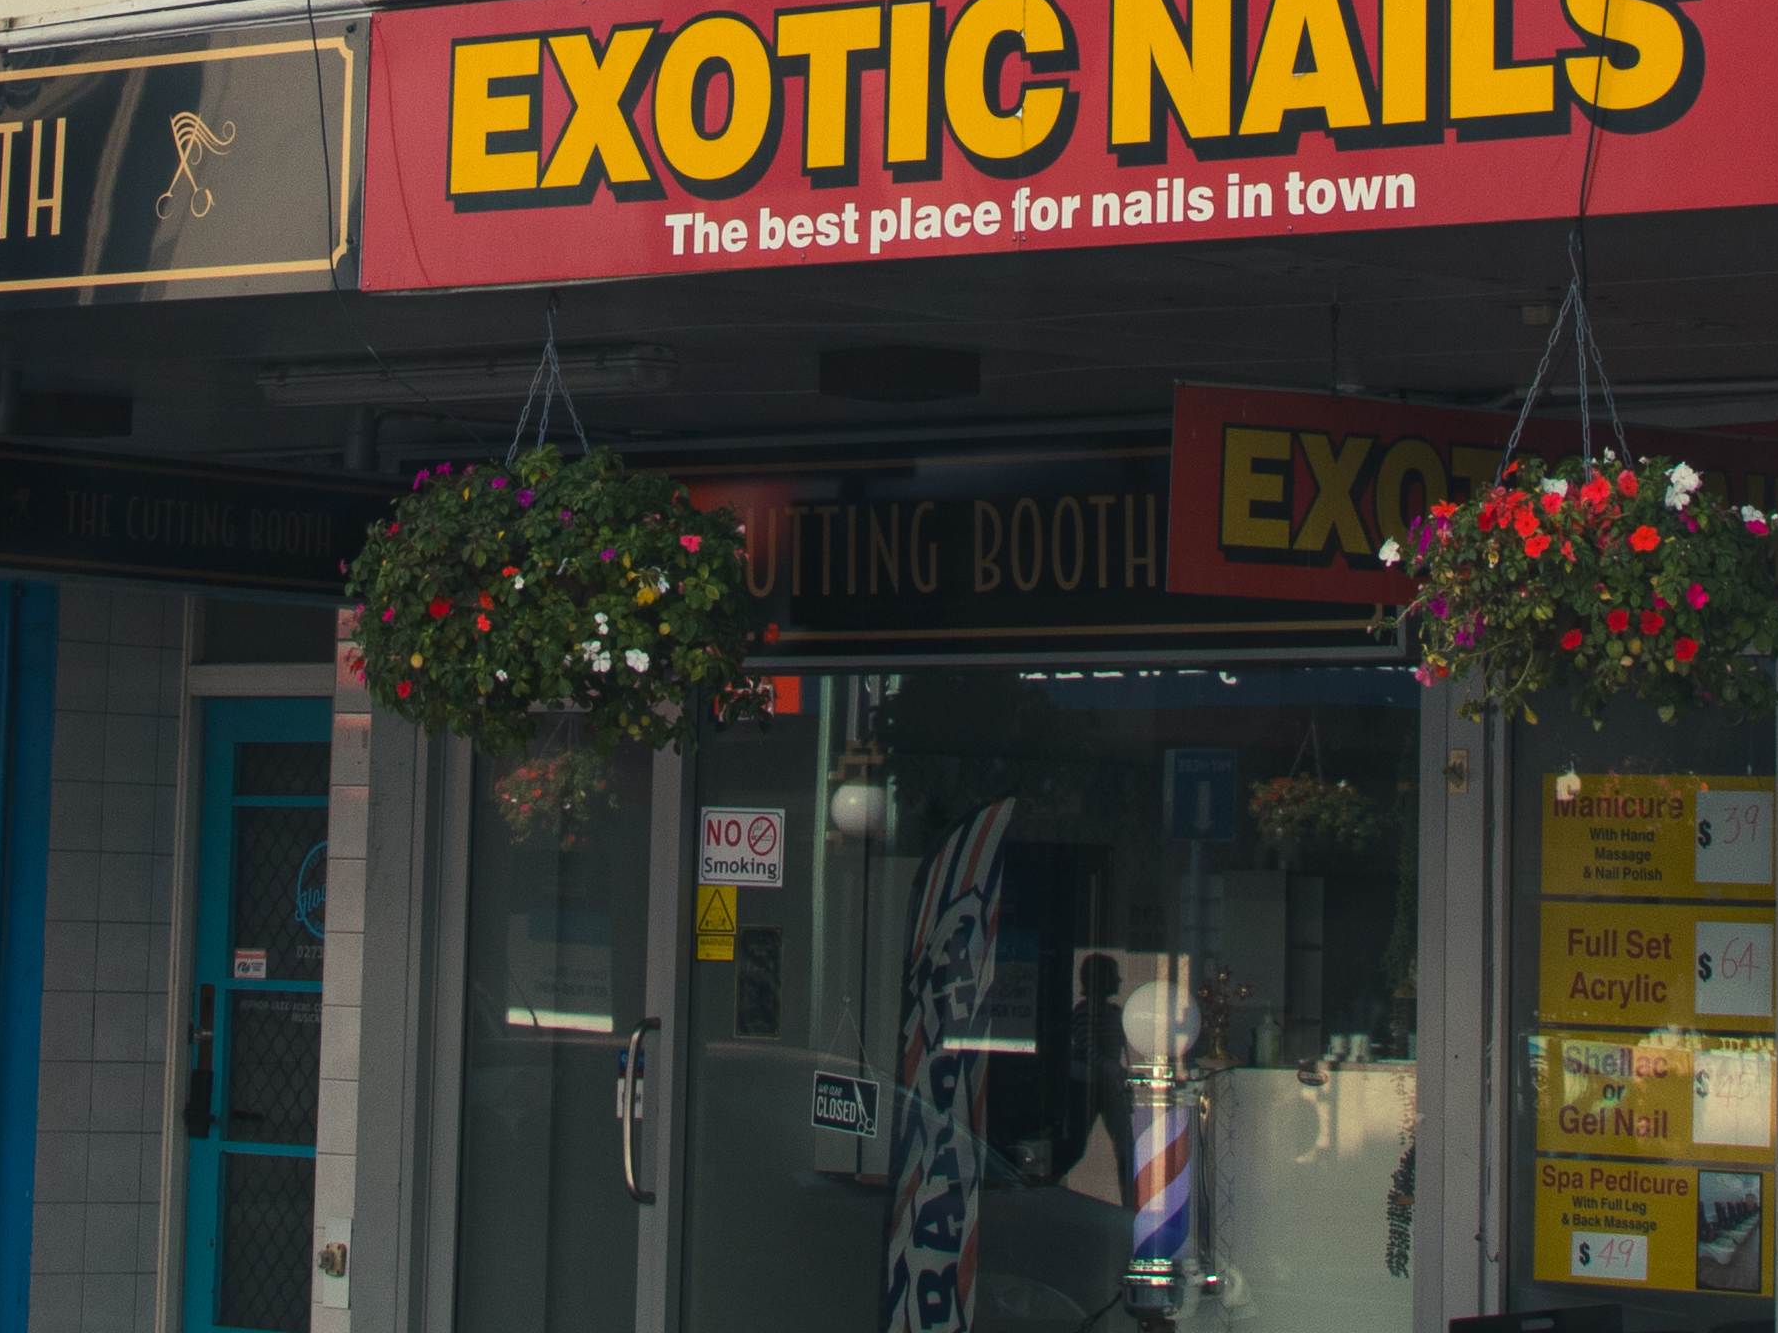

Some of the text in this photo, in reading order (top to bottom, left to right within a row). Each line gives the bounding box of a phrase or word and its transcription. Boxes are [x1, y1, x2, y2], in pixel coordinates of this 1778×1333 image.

[666, 164, 1416, 258] The best place for nails in town
[66, 490, 331, 557] THE CUTTING BOOTH
[745, 494, 1156, 598] UTTING BOOTH
[1553, 790, 1684, 820] Manicure
[706, 819, 741, 847] NO
[1590, 827, 1654, 842] With Hand
[1698, 804, 1759, 849] $ 39
[704, 857, 777, 879] Smoking
[1595, 847, 1651, 865] Massage
[1583, 866, 1662, 881] & Nail Polish
[699, 937, 733, 947] WARNING
[1568, 928, 1672, 960] Full Set
[1698, 937, 1760, 982] $ 64
[1569, 972, 1667, 1009] Acrylic
[1564, 1046, 1668, 1079] Shellac
[1603, 1083, 1626, 1101] or
[817, 1096, 857, 1123] CLOSED
[1559, 1105, 1668, 1139] Gel Nail
[1542, 1165, 1689, 1197] Spa Pedicure
[1572, 1196, 1647, 1216] With Full Leg
[1562, 1213, 1658, 1234] & Back Massage
[1579, 1238, 1635, 1269] $ 49
